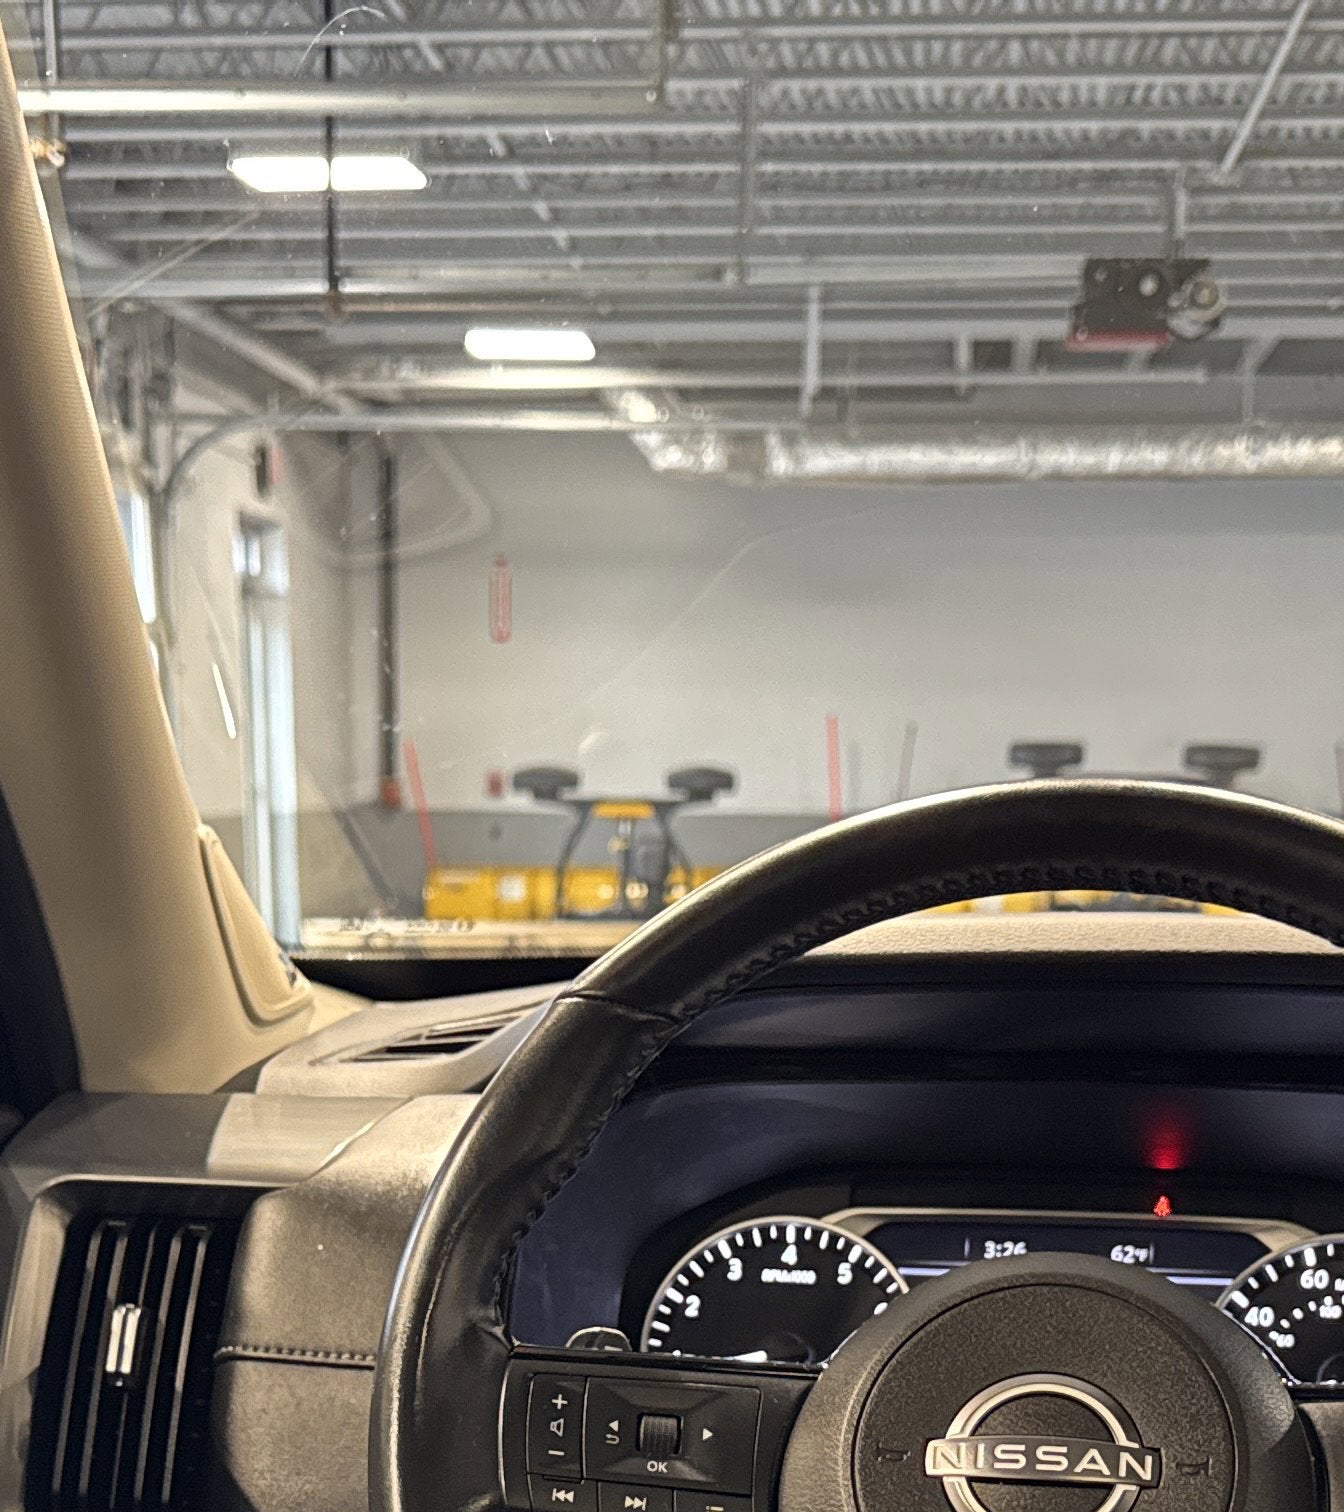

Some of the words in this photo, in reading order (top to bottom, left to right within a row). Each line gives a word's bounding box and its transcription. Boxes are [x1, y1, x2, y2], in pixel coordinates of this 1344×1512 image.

[780, 1244, 798, 1266] 4
[983, 1240, 1027, 1260] 3:26
[726, 1257, 743, 1282] 3
[836, 1261, 853, 1286] 5
[1299, 1268, 1330, 1290] 60
[684, 1294, 702, 1318] 2
[1244, 1305, 1275, 1328] 40
[646, 1460, 669, 1474] OK
[932, 1442, 1154, 1481] NISSAN
